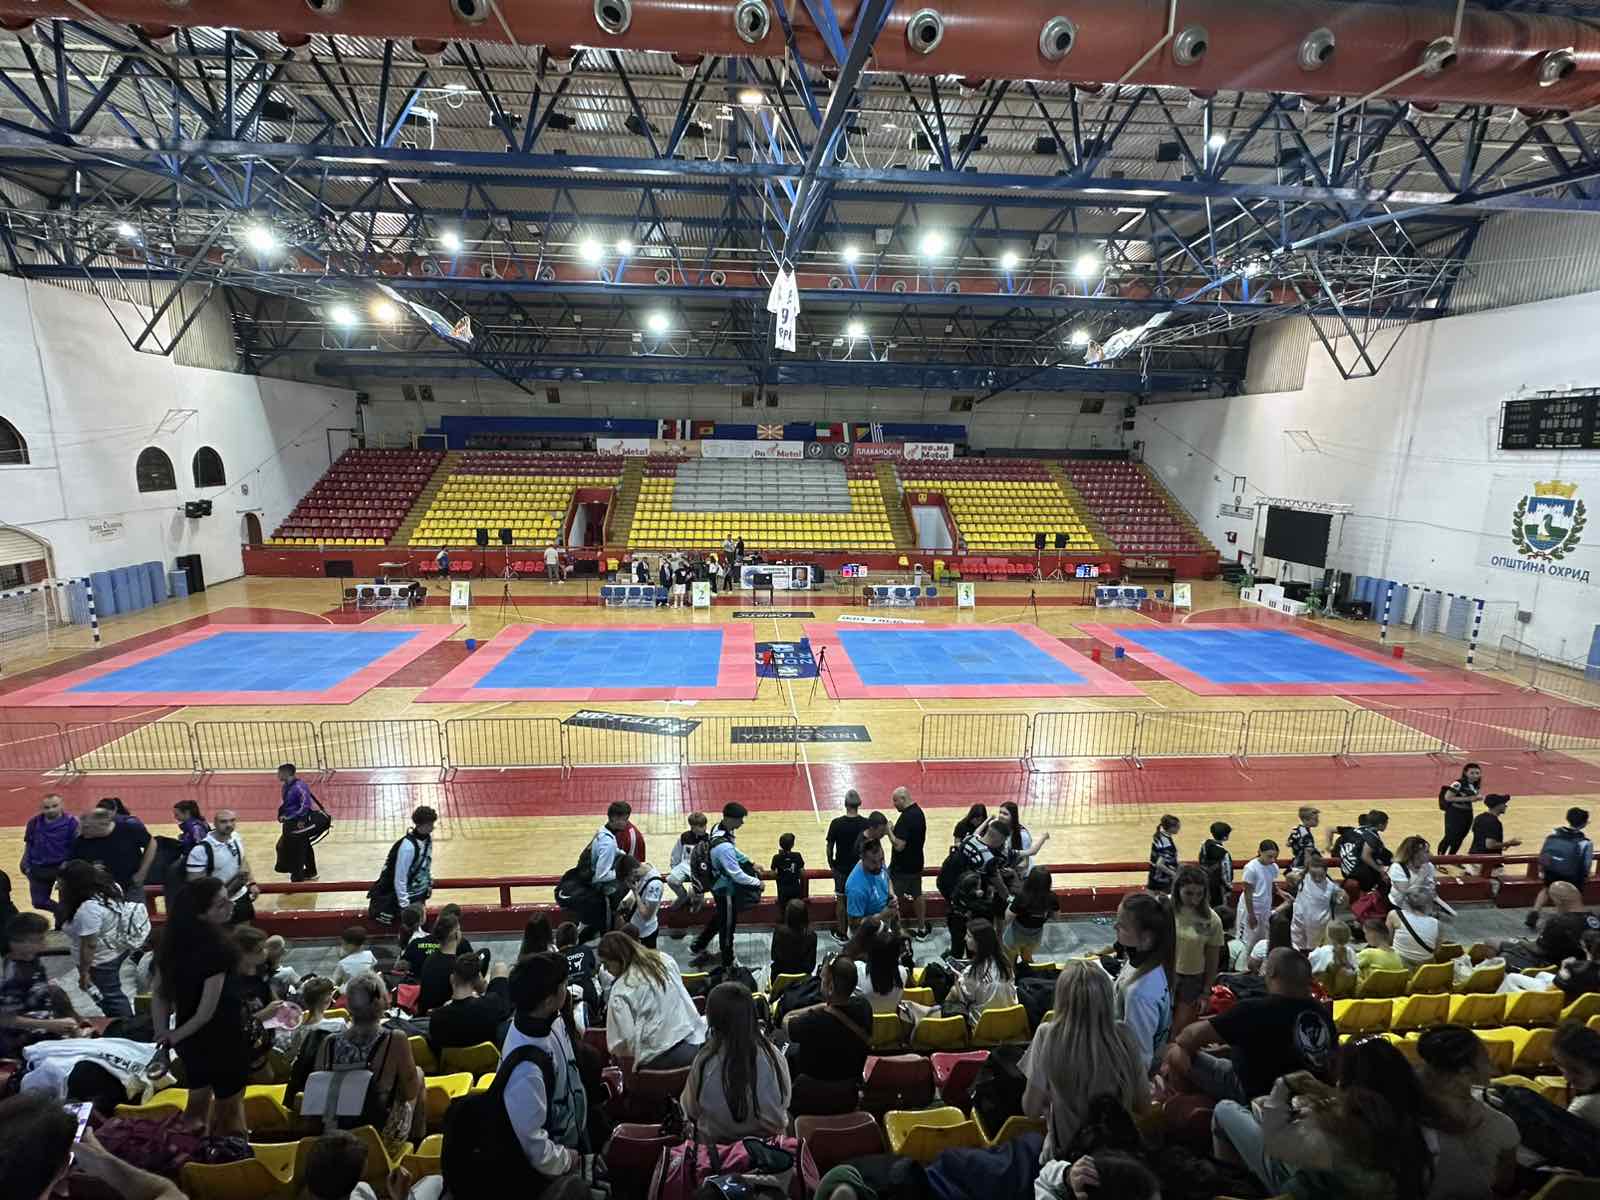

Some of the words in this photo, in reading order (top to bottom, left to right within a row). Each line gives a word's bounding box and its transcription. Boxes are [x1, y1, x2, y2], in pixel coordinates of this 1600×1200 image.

[1491, 556, 1545, 574] ОПШТИНА
[1548, 565, 1590, 583] ОХРИД
[698, 590, 705, 600] 2
